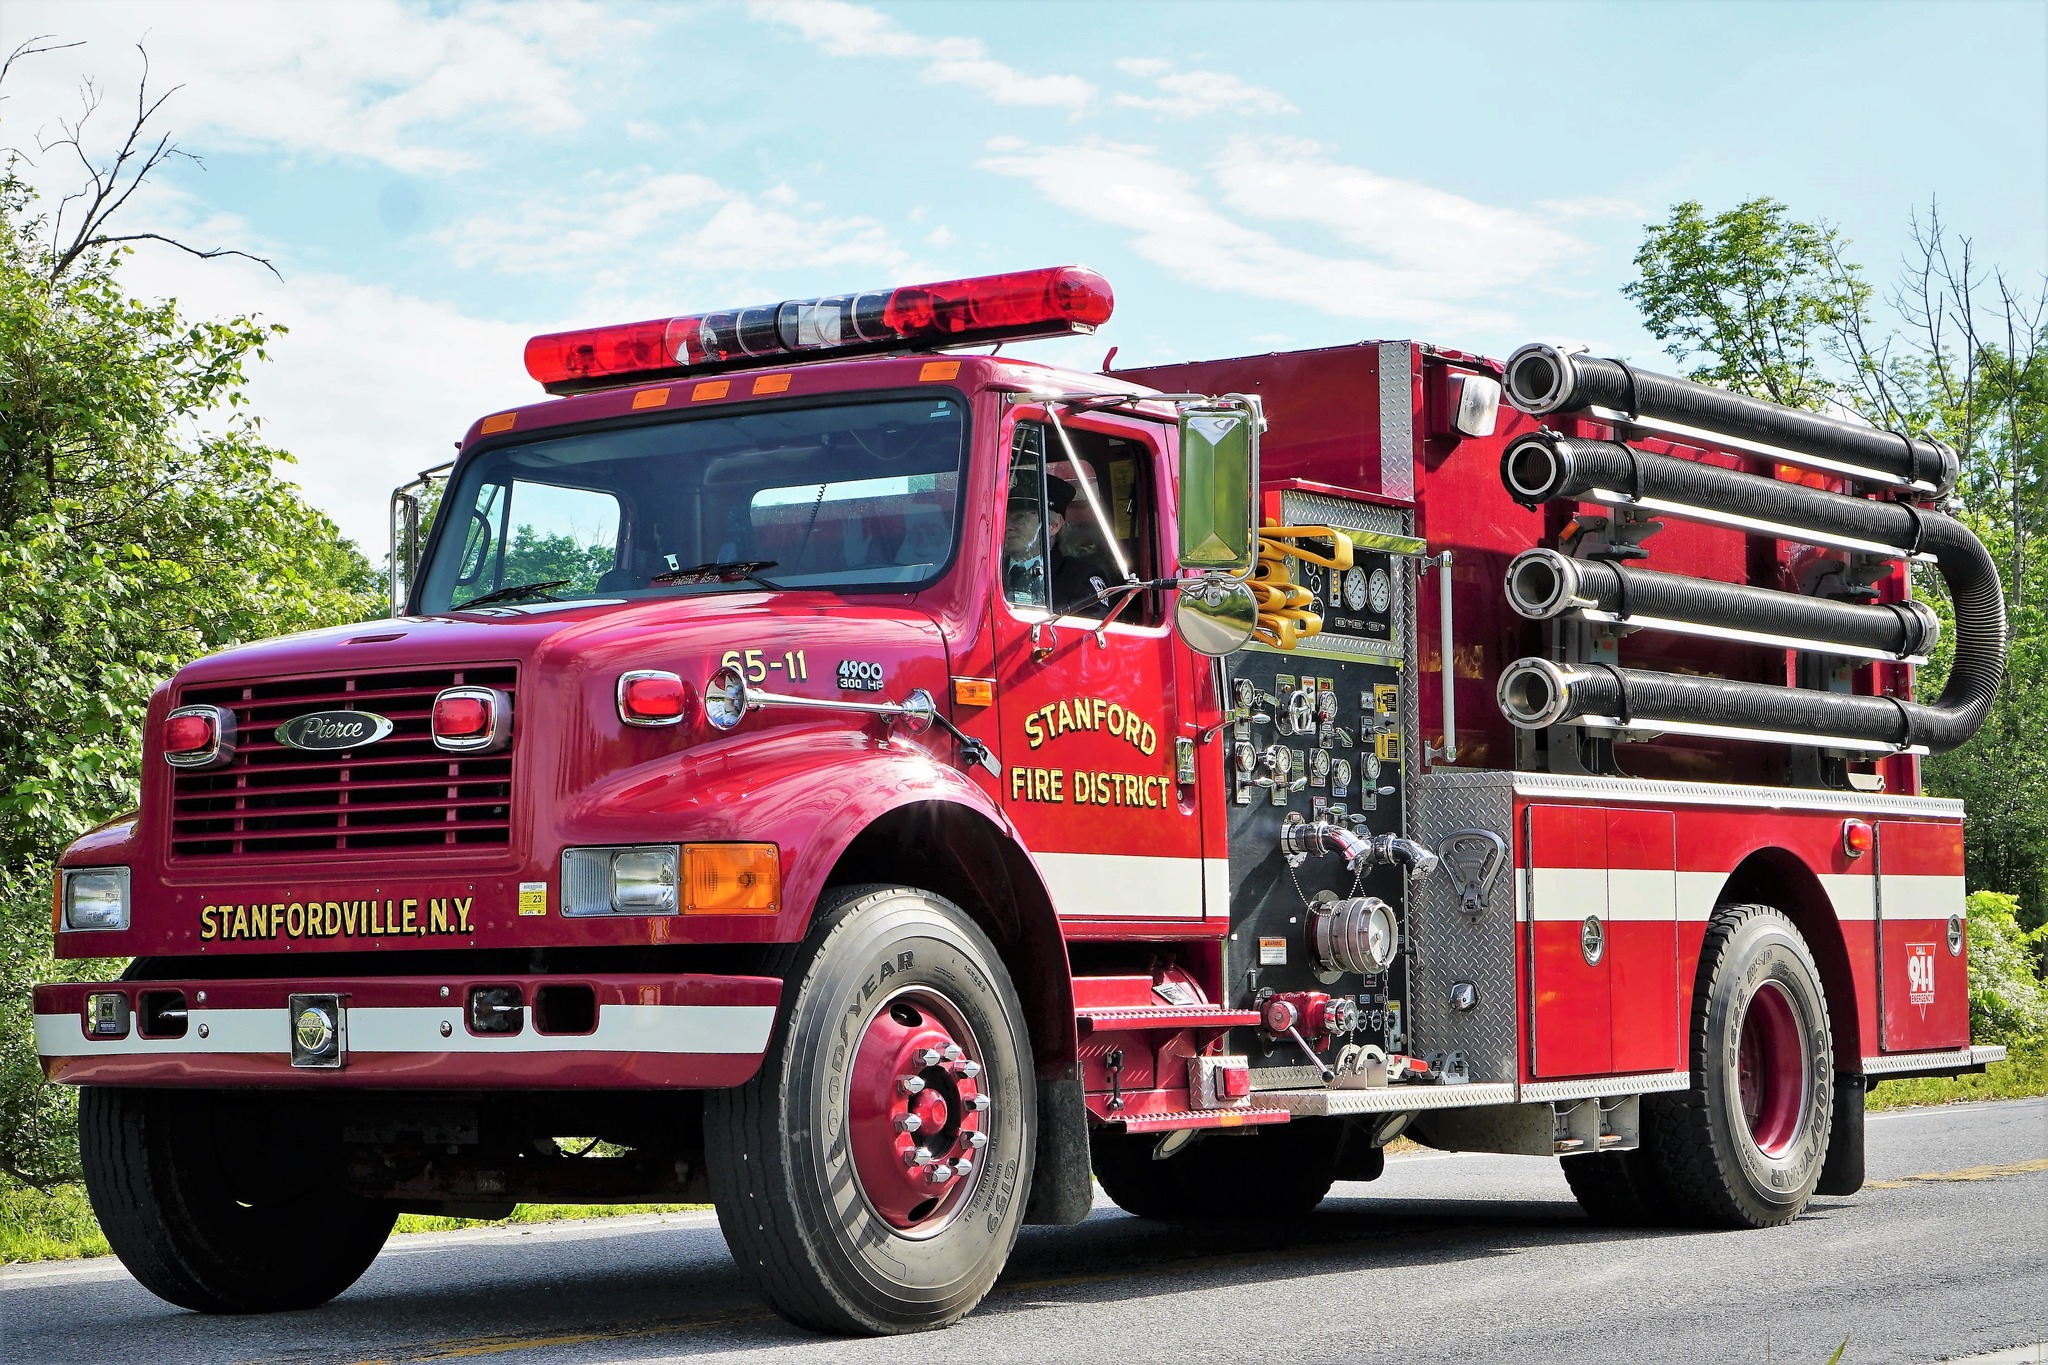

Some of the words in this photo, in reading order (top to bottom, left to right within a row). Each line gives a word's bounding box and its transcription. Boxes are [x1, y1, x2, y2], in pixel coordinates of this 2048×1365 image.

[721, 650, 808, 684] 65-11
[838, 660, 884, 681] 4900
[840, 678, 862, 689] 300
[867, 680, 884, 690] HP
[298, 717, 365, 746] Pierce
[1024, 696, 1158, 757] STANFORD
[1011, 766, 1065, 802] FIRE
[1073, 770, 1171, 809] DISTRICT
[533, 894, 542, 904] 23
[1915, 946, 1927, 956] CALL
[1911, 993, 1934, 1003] EMERGENCY
[1770, 1029, 1828, 1189] GOODYEAR
[986, 1158, 1017, 1235] G159
